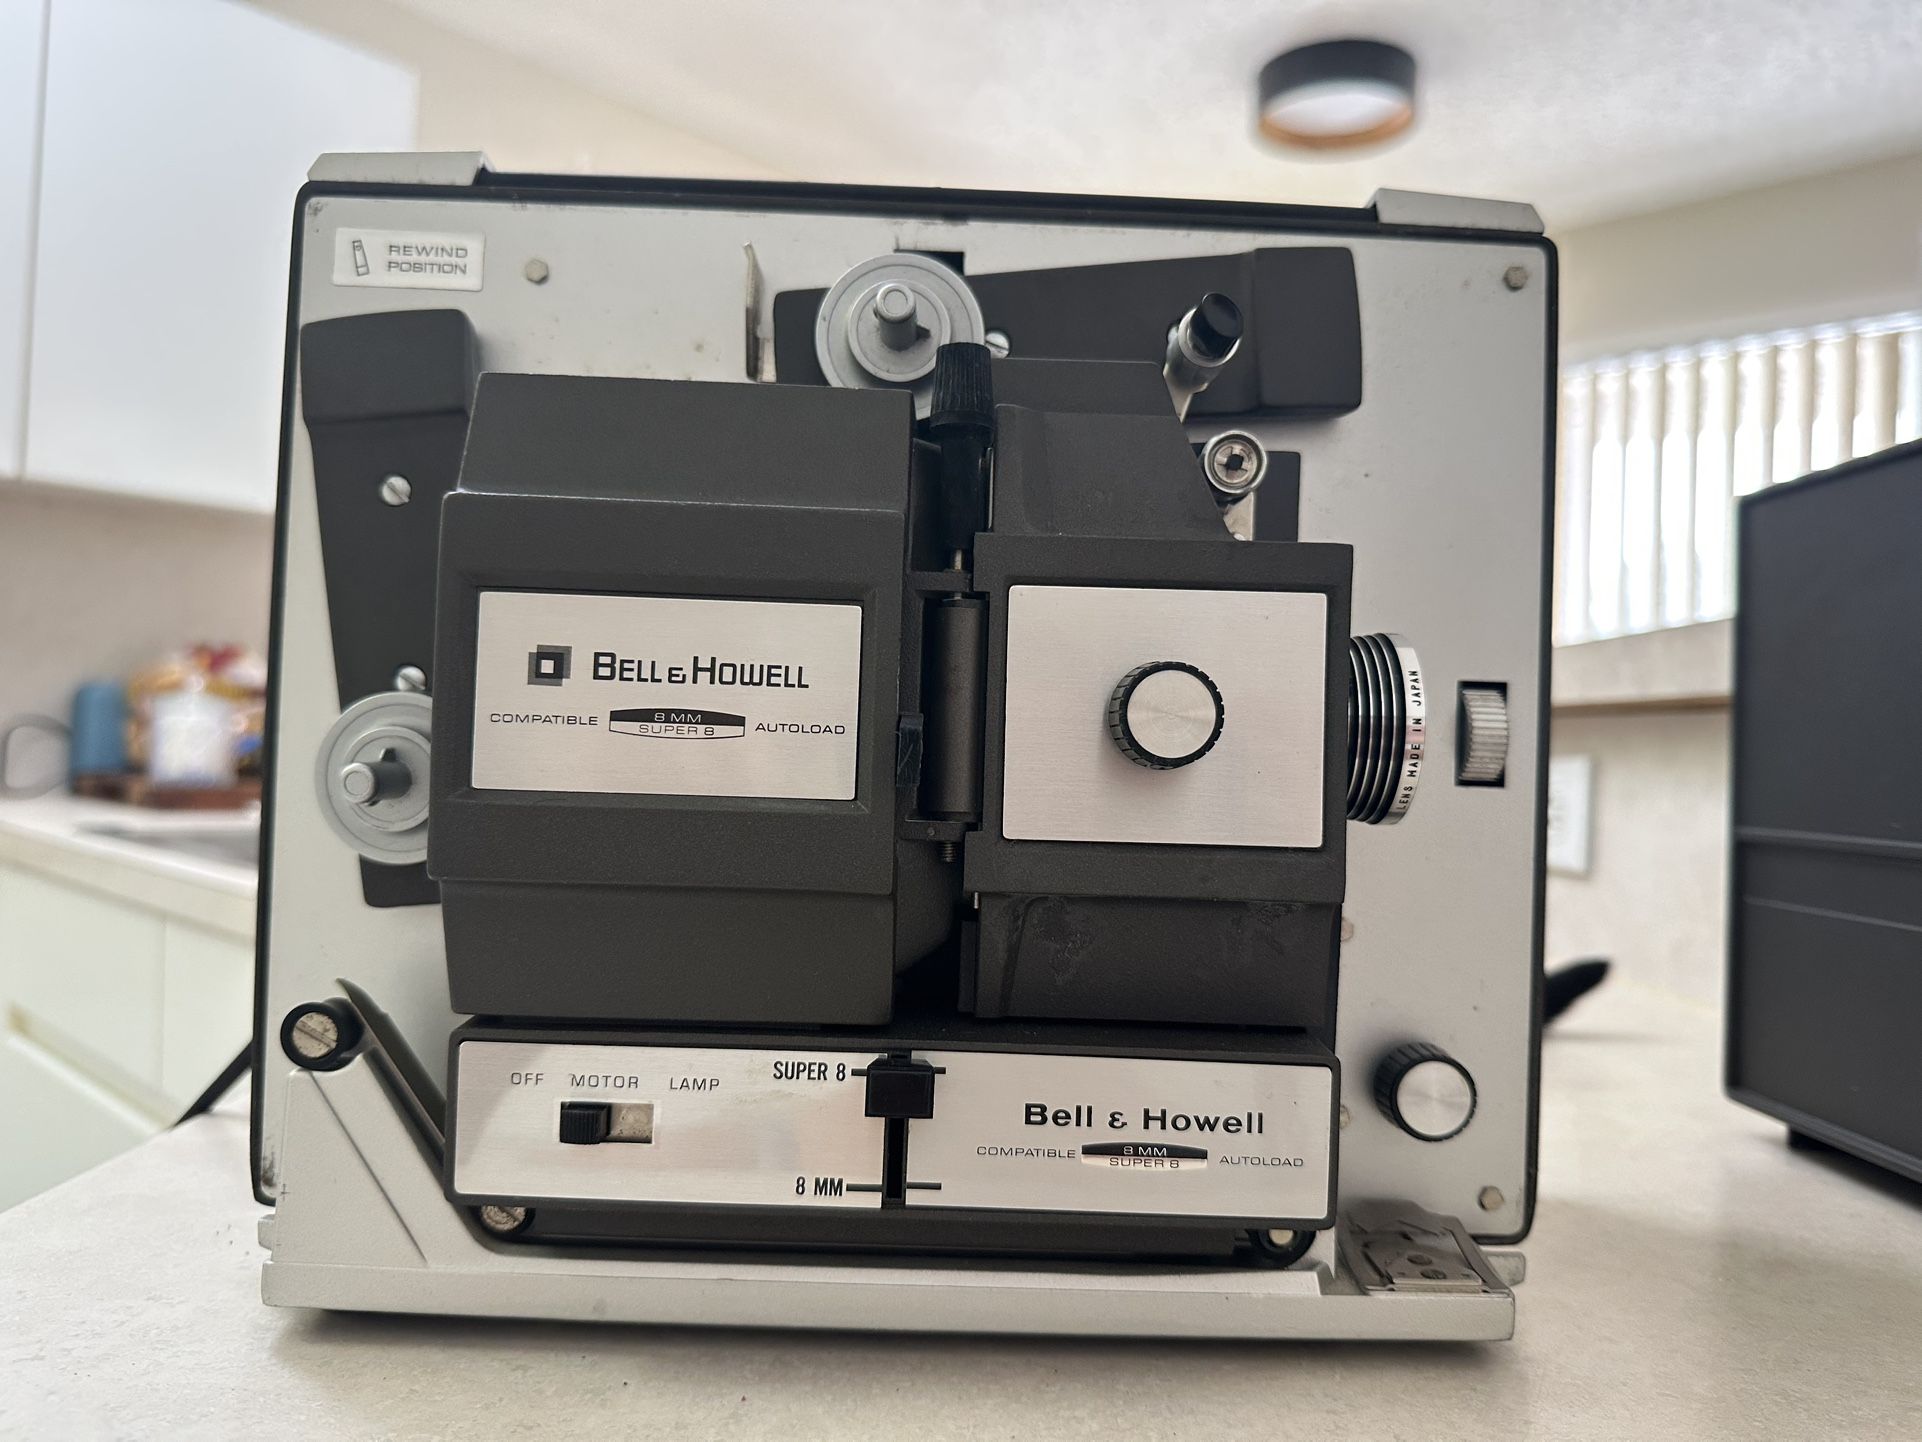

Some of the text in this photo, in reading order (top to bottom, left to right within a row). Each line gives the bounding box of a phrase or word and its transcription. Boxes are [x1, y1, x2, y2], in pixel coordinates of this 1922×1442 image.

[388, 244, 468, 259] REWIND
[387, 261, 467, 275] POSITION
[593, 651, 810, 689] BELL & HOWELL
[490, 712, 599, 727] COMPATIBLE
[654, 712, 701, 724] 8 MM
[638, 723, 715, 737] SUPER 8
[754, 722, 846, 735] AUTOLOAD
[1396, 670, 1422, 811] LENS MADE IN JAPAN
[510, 1071, 545, 1087] OFF
[773, 1061, 847, 1083] SUPER 8
[571, 1074, 640, 1089] MOTOR
[669, 1076, 720, 1091] LAMP
[1023, 1102, 1265, 1134] Bell & Howell
[976, 1145, 1077, 1159] COMPATIBLE
[1123, 1145, 1168, 1158] 8 MM
[1109, 1157, 1180, 1169] SUPER 8
[1219, 1155, 1305, 1168] AUTOLOAD
[795, 1177, 844, 1197] 8 MM
